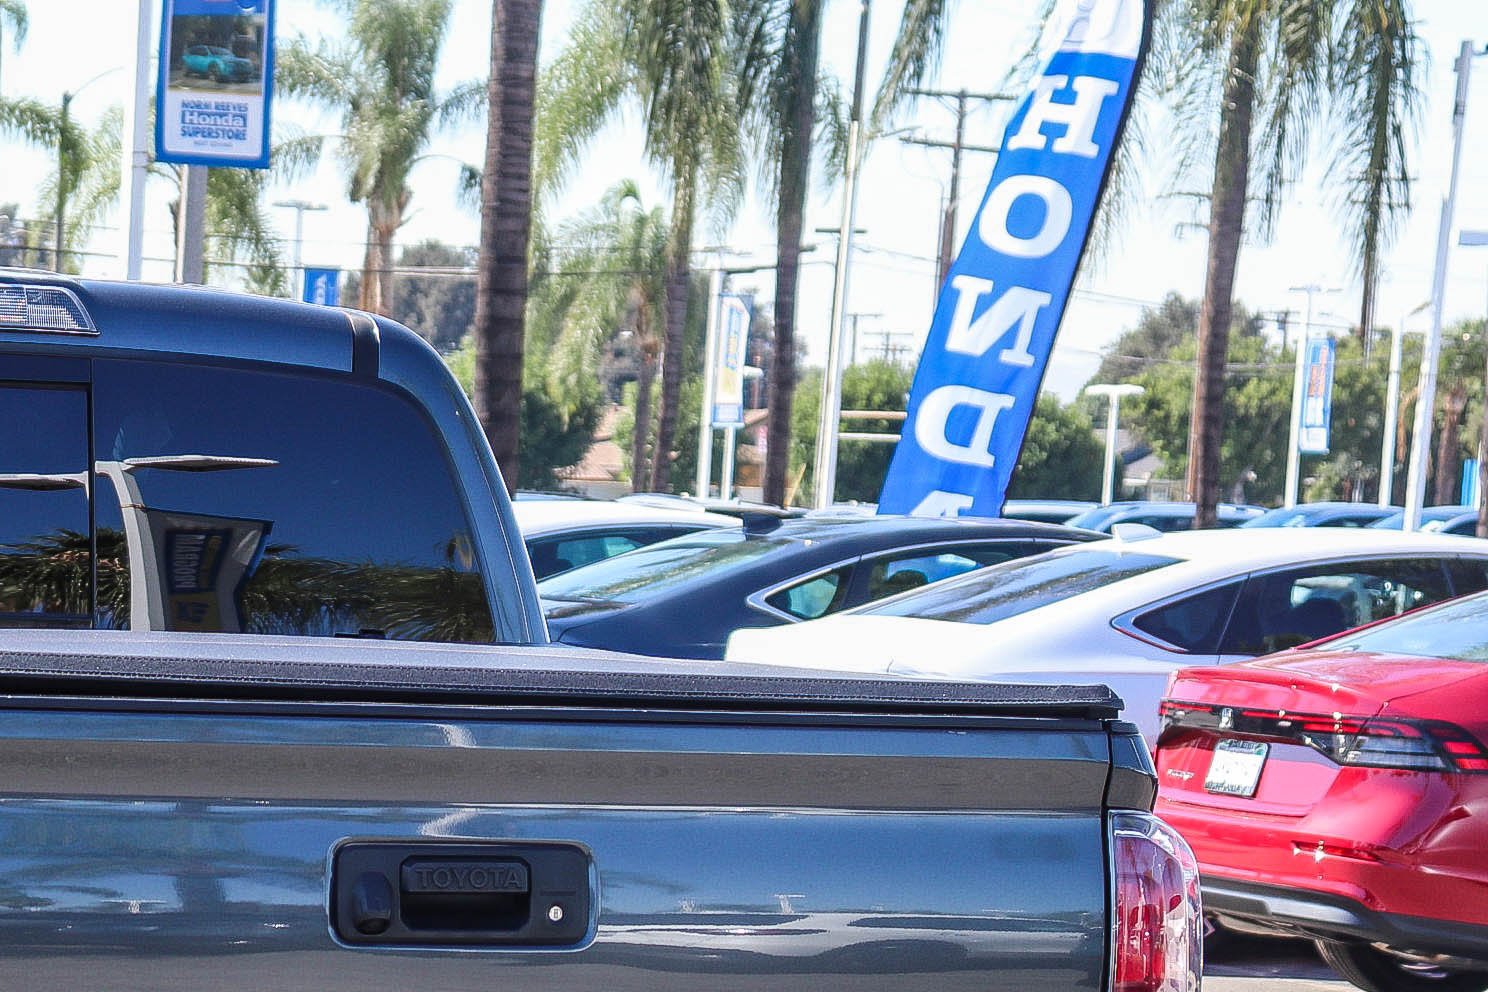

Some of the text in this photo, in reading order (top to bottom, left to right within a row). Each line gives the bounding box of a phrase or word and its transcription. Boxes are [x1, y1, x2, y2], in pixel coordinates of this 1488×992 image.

[184, 110, 244, 126] Honda
[179, 125, 248, 141] SUPERSTORE
[416, 866, 522, 890] TOYOTA
